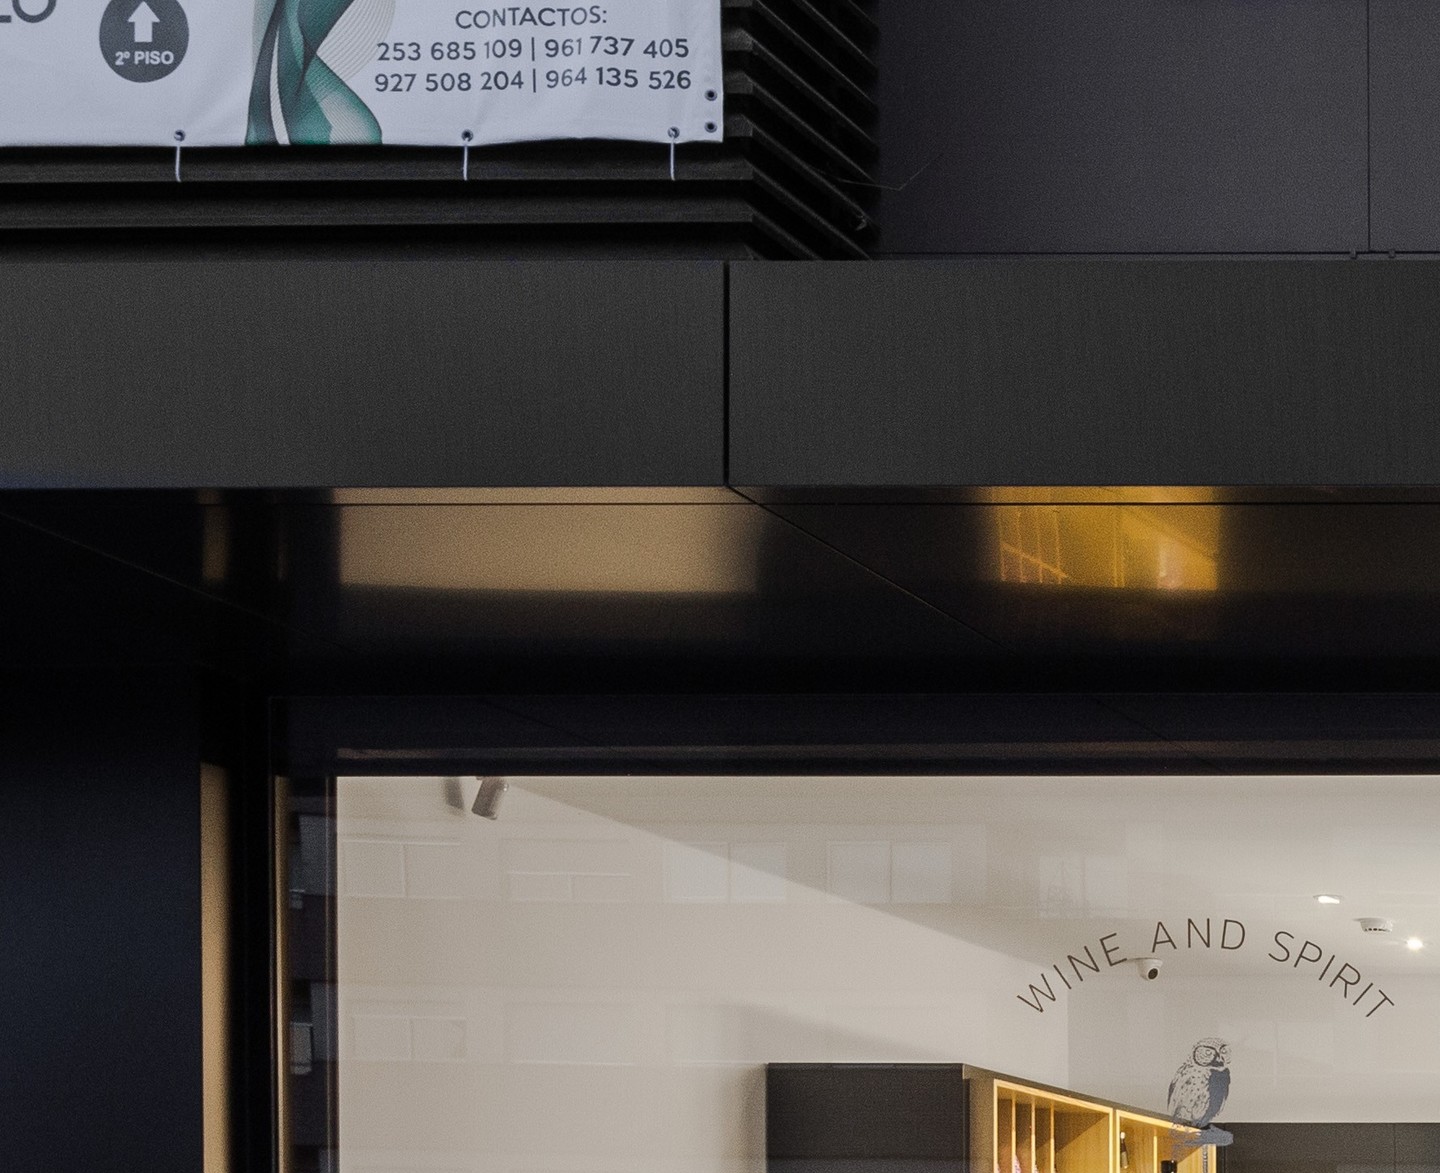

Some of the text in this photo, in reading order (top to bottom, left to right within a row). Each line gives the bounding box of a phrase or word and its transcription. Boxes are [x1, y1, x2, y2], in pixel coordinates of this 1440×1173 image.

[455, 5, 608, 29] CONTACTOS:
[134, 50, 174, 65] PISO
[377, 42, 421, 61] 253
[430, 41, 476, 61] 685
[485, 38, 522, 59] 109
[545, 38, 582, 58] 961
[590, 36, 635, 57] 737
[643, 38, 689, 59] 405
[374, 73, 417, 93] 927
[425, 72, 472, 92] 508
[480, 70, 524, 91] 204
[545, 67, 587, 89] 964
[596, 67, 639, 88] 135
[648, 70, 692, 90] 526
[1017, 917, 1396, 1019] WINE AND SPIRIT
